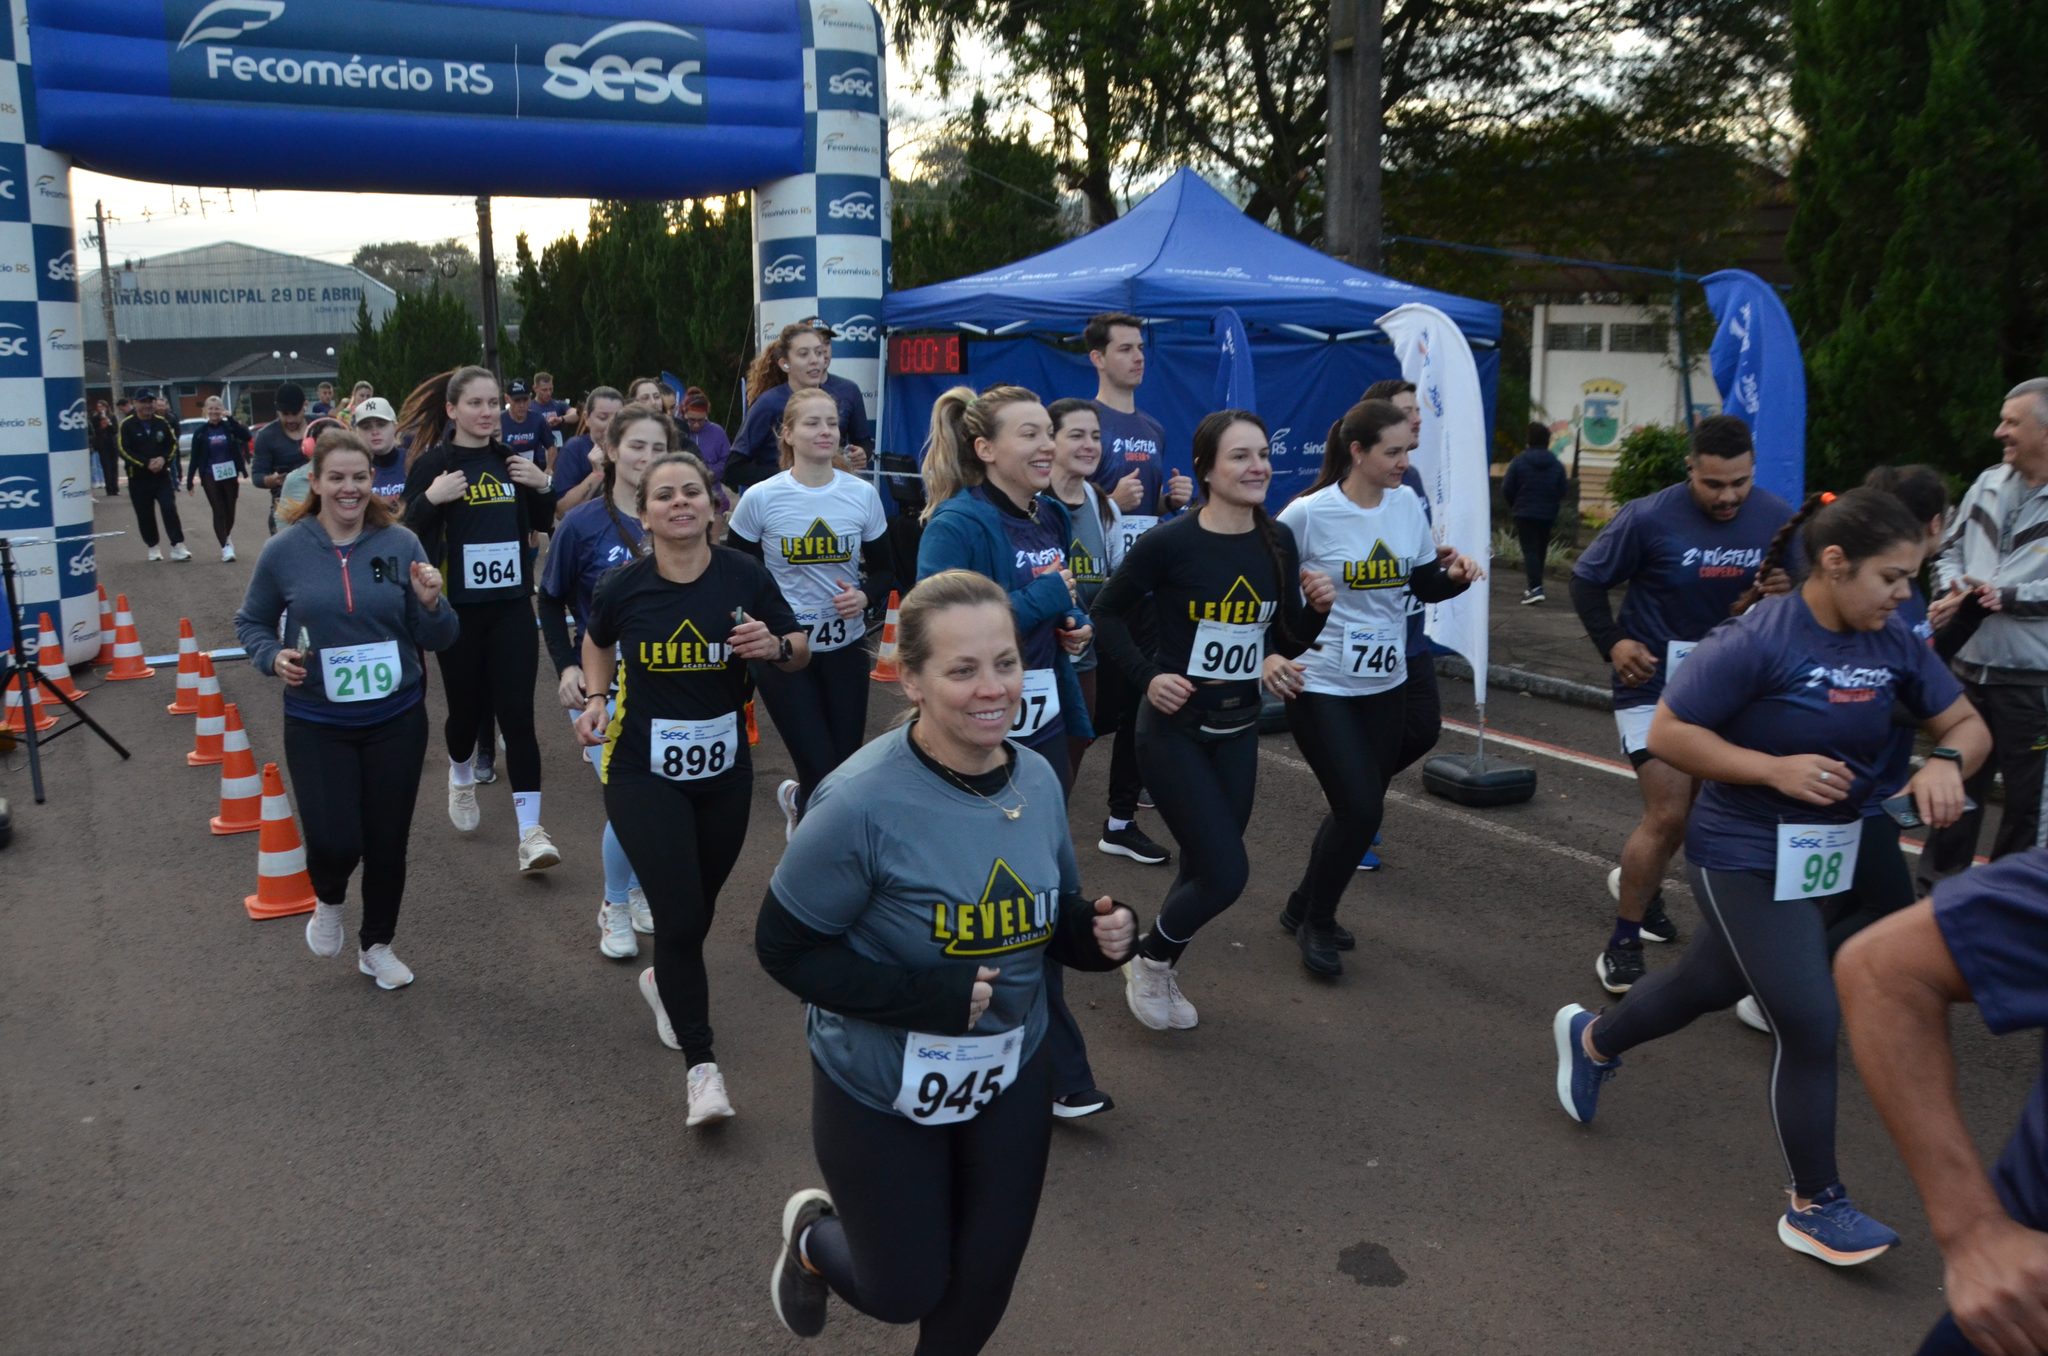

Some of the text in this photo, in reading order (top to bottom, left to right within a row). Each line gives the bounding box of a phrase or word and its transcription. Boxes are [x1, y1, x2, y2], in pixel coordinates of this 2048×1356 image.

[207, 46, 494, 96] Fecomércio RS
[827, 143, 870, 153] Fecomércio
[827, 267, 871, 277] Fecomércio
[176, 287, 266, 305] MUNICIPAL
[271, 287, 292, 303] 29
[296, 287, 316, 302] DE
[1271, 442, 1287, 455] RS
[472, 559, 515, 585] 964
[800, 619, 846, 646] 743
[1201, 641, 1258, 675] 900
[1351, 645, 1398, 673] 746
[334, 662, 393, 697] 219
[662, 740, 727, 777] 898
[1801, 851, 1844, 893] 98
[912, 1064, 1006, 1118] 945
